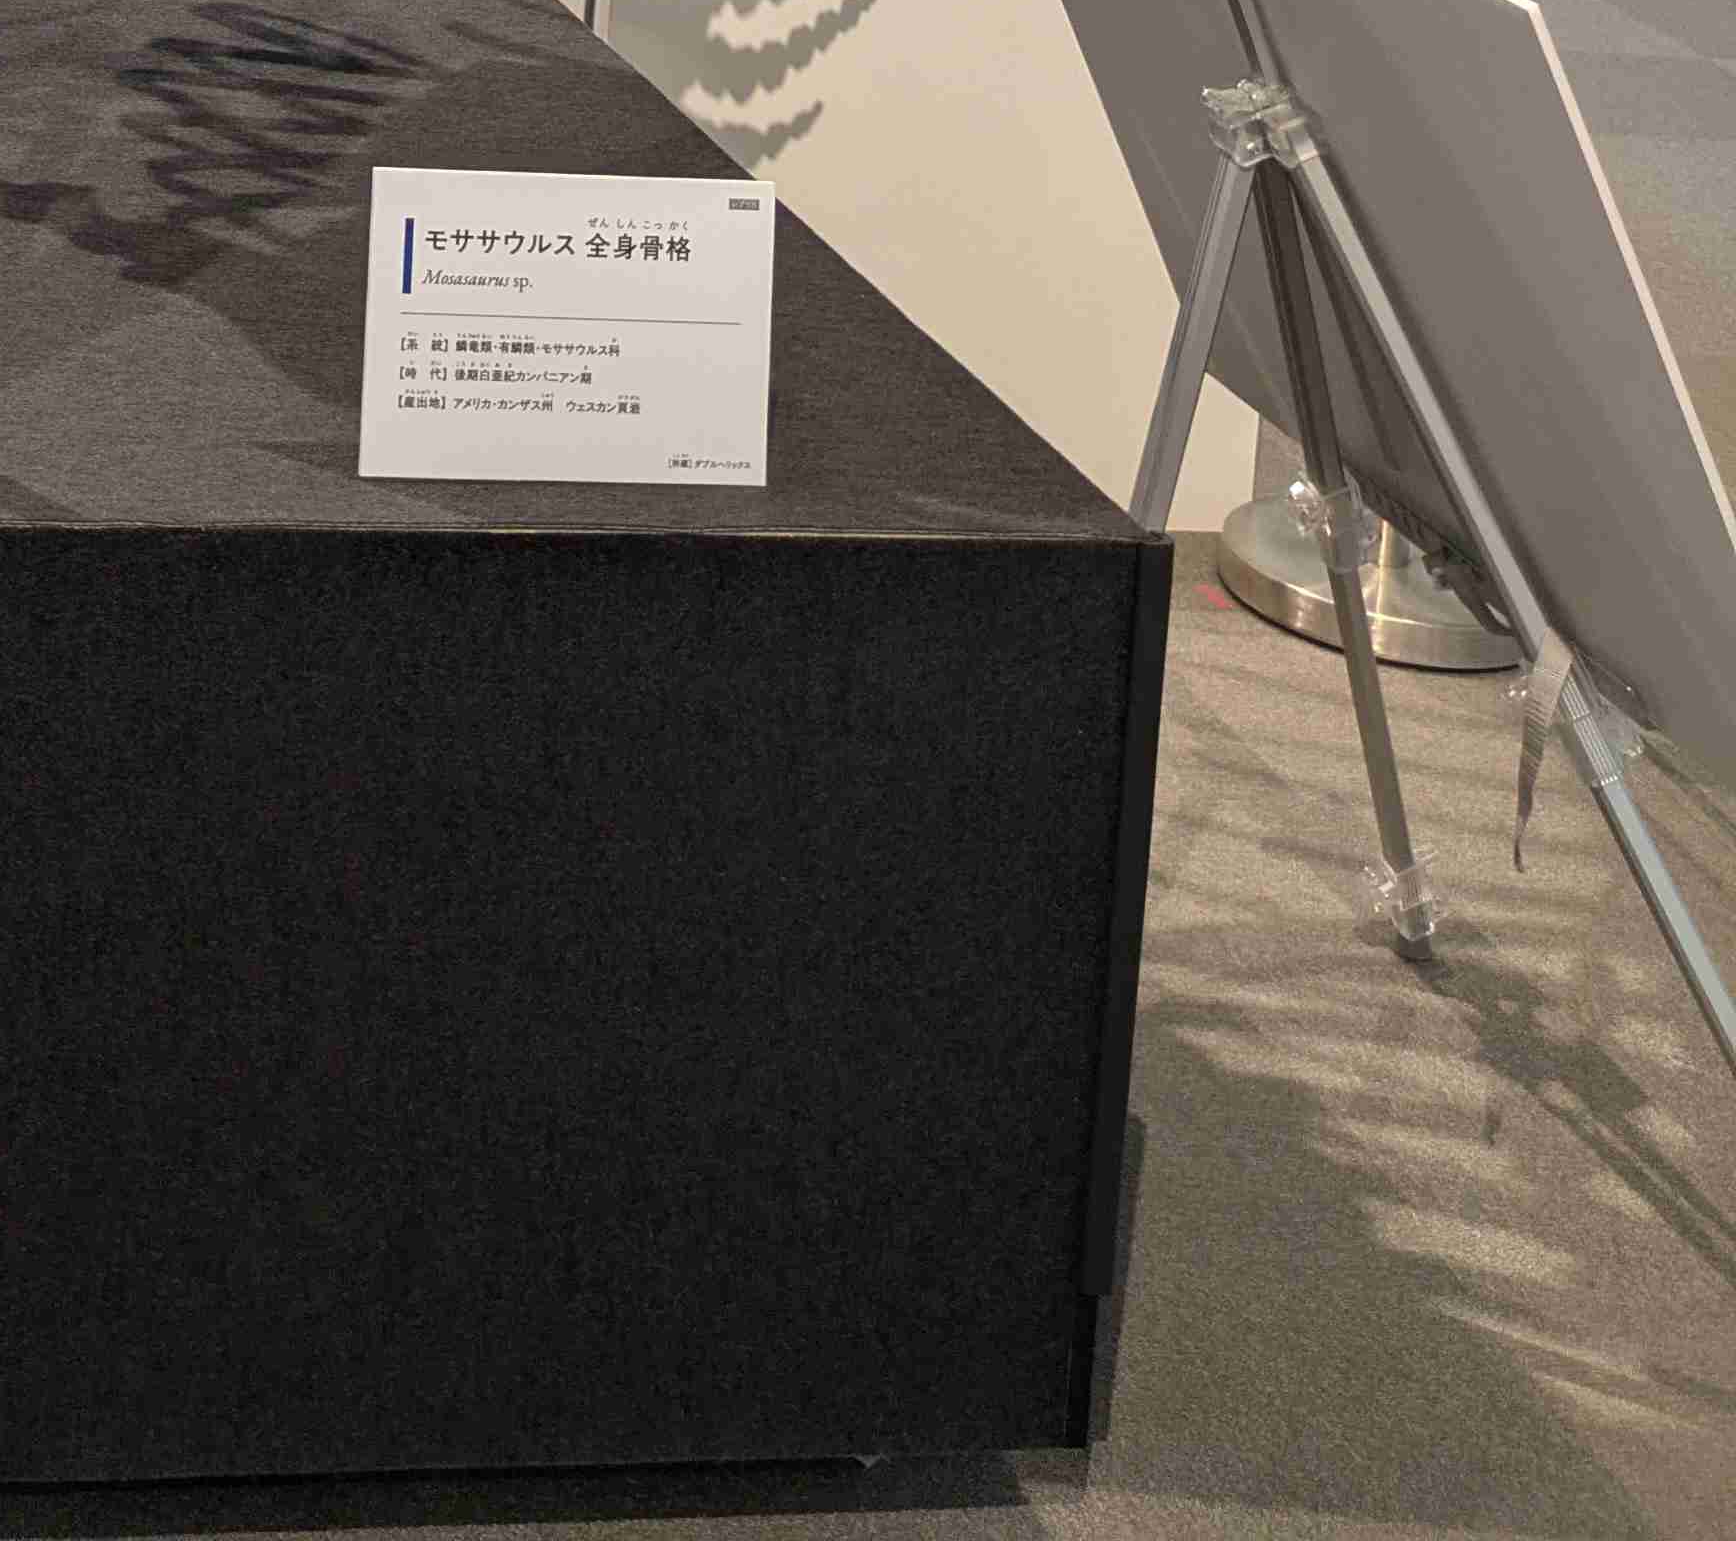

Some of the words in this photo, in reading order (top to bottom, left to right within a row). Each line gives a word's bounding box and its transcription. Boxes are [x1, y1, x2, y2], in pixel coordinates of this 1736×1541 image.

[425, 228, 575, 256] モササウルス
[585, 232, 691, 262] 全身骨格
[422, 268, 510, 288] Mosasaurus
[512, 276, 534, 293] sp.
